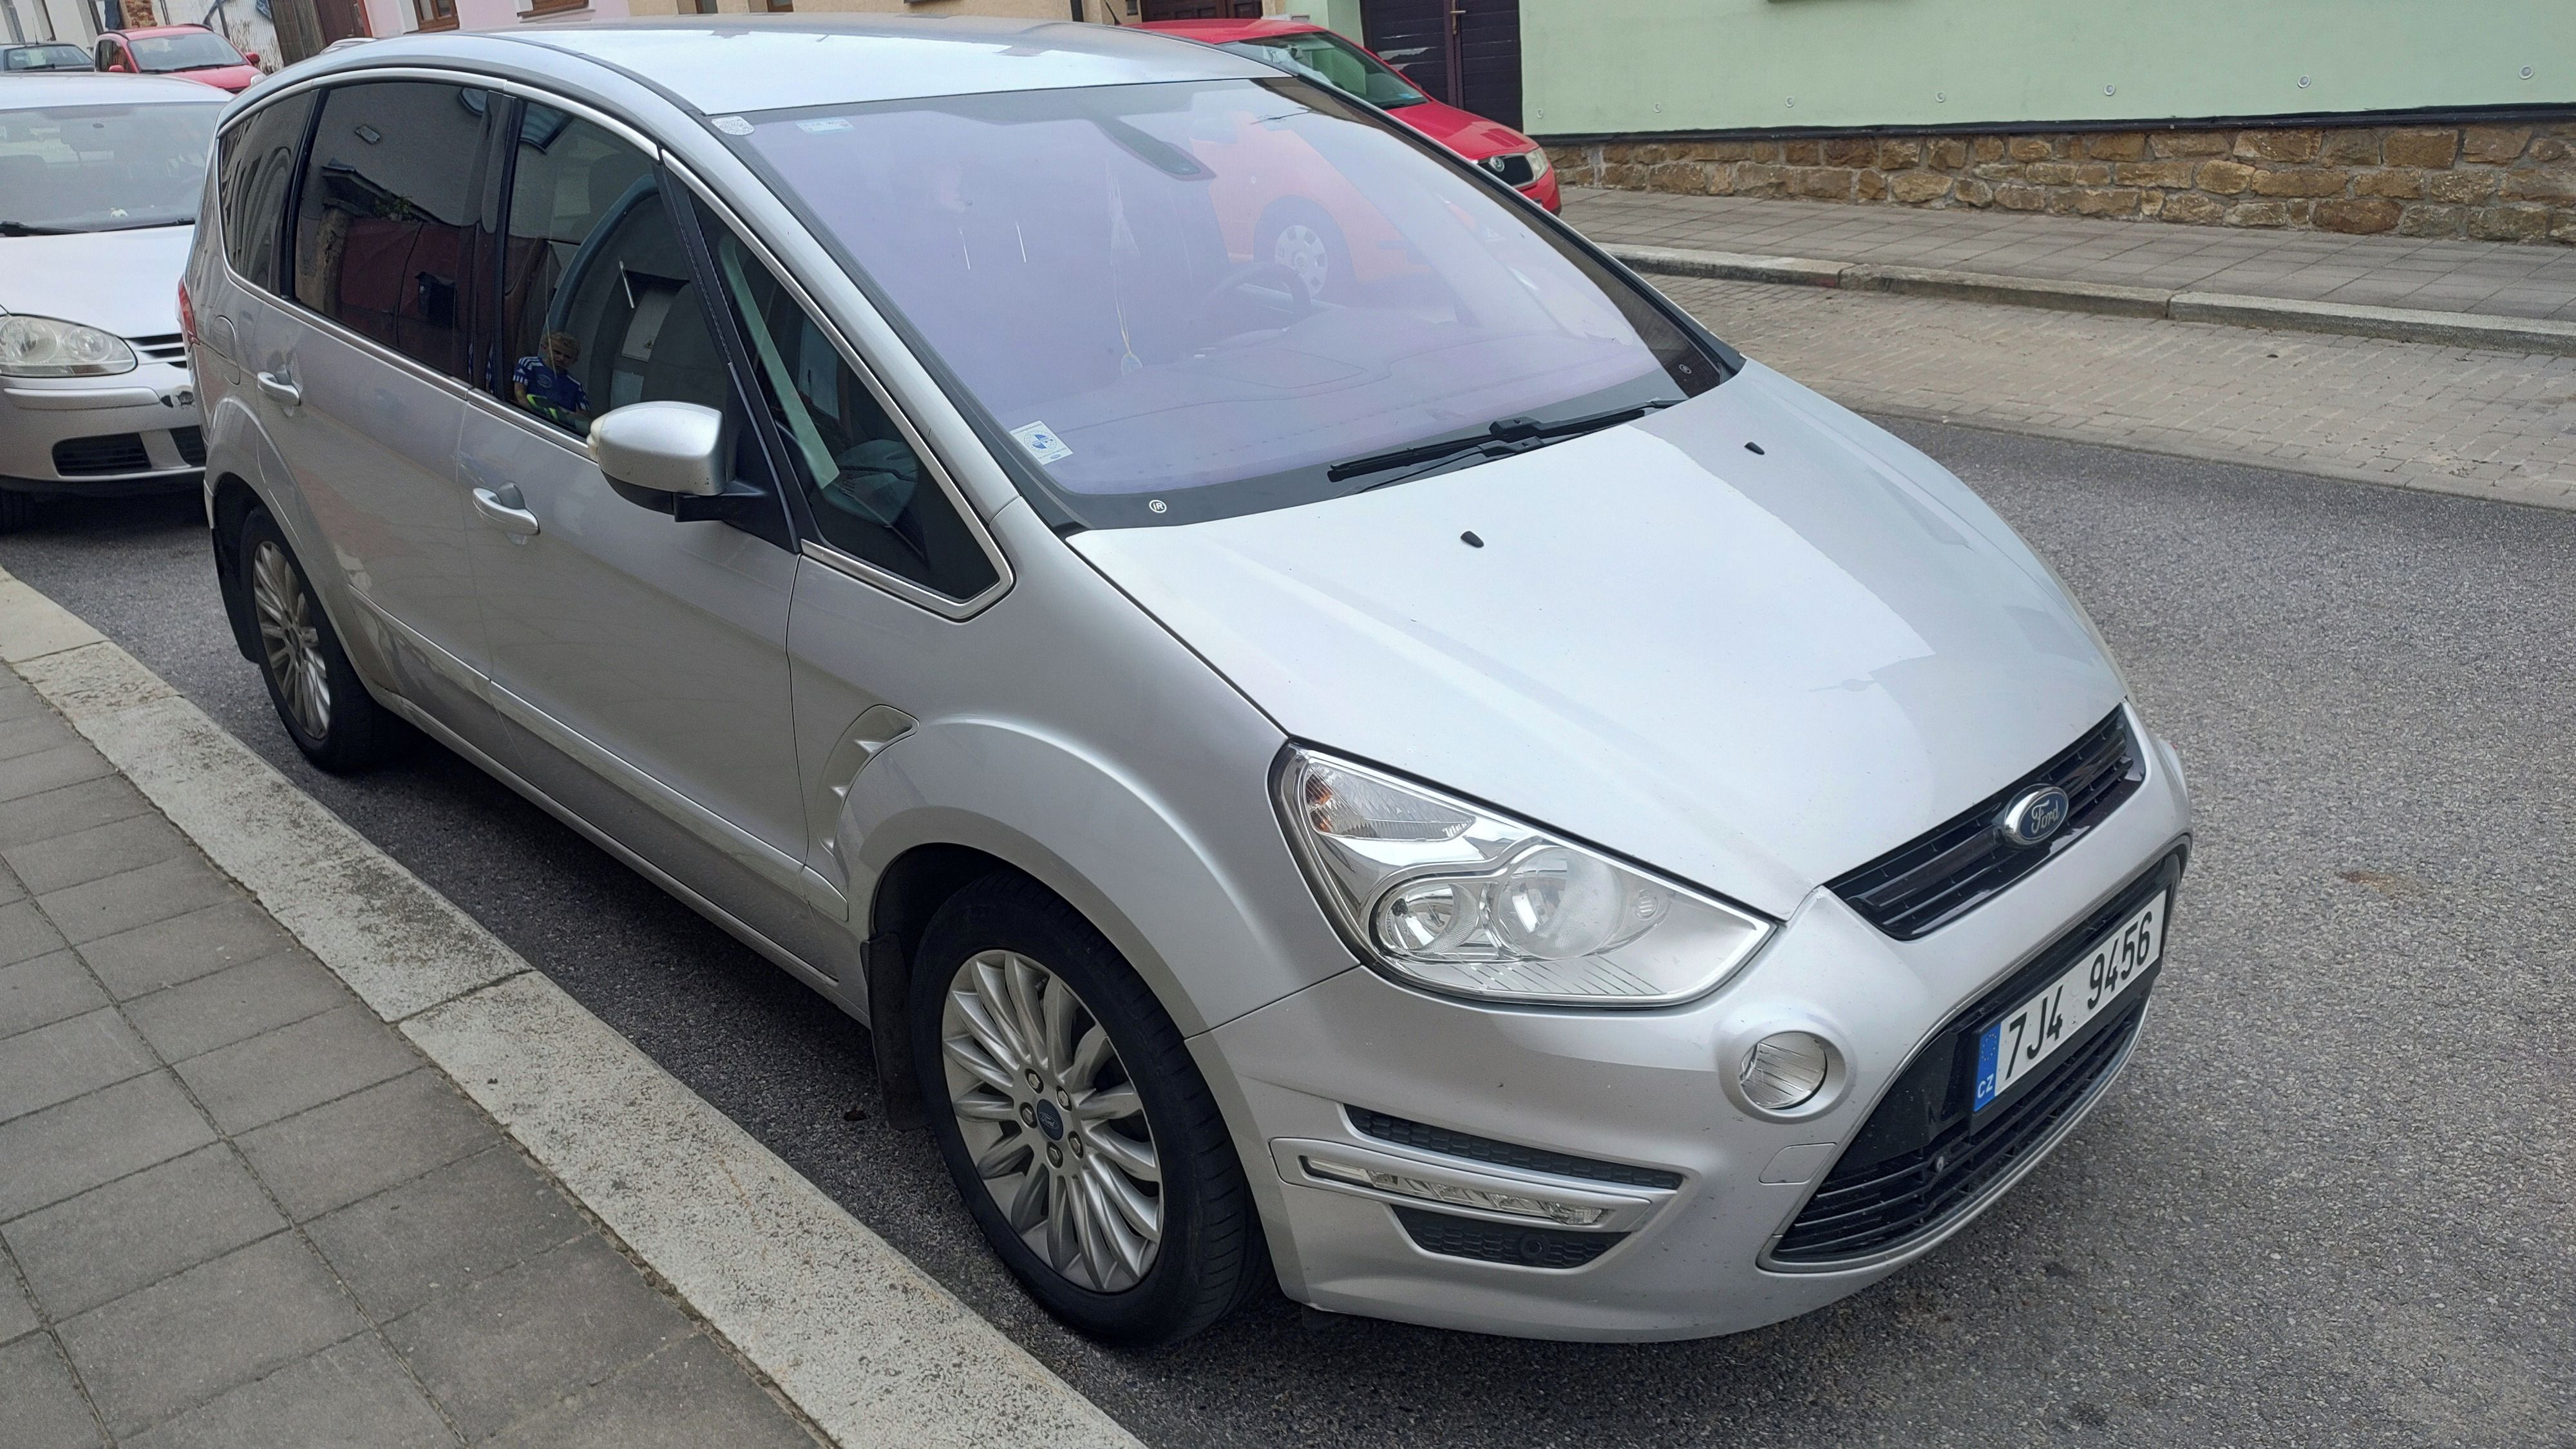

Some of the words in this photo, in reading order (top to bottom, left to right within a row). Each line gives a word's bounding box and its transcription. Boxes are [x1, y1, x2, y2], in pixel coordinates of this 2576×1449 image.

[2031, 799, 2060, 834] Ford
[2005, 984, 2063, 1081] 7J4
[2087, 911, 2153, 1010] 9456
[1978, 1074, 1994, 1099] CZ
